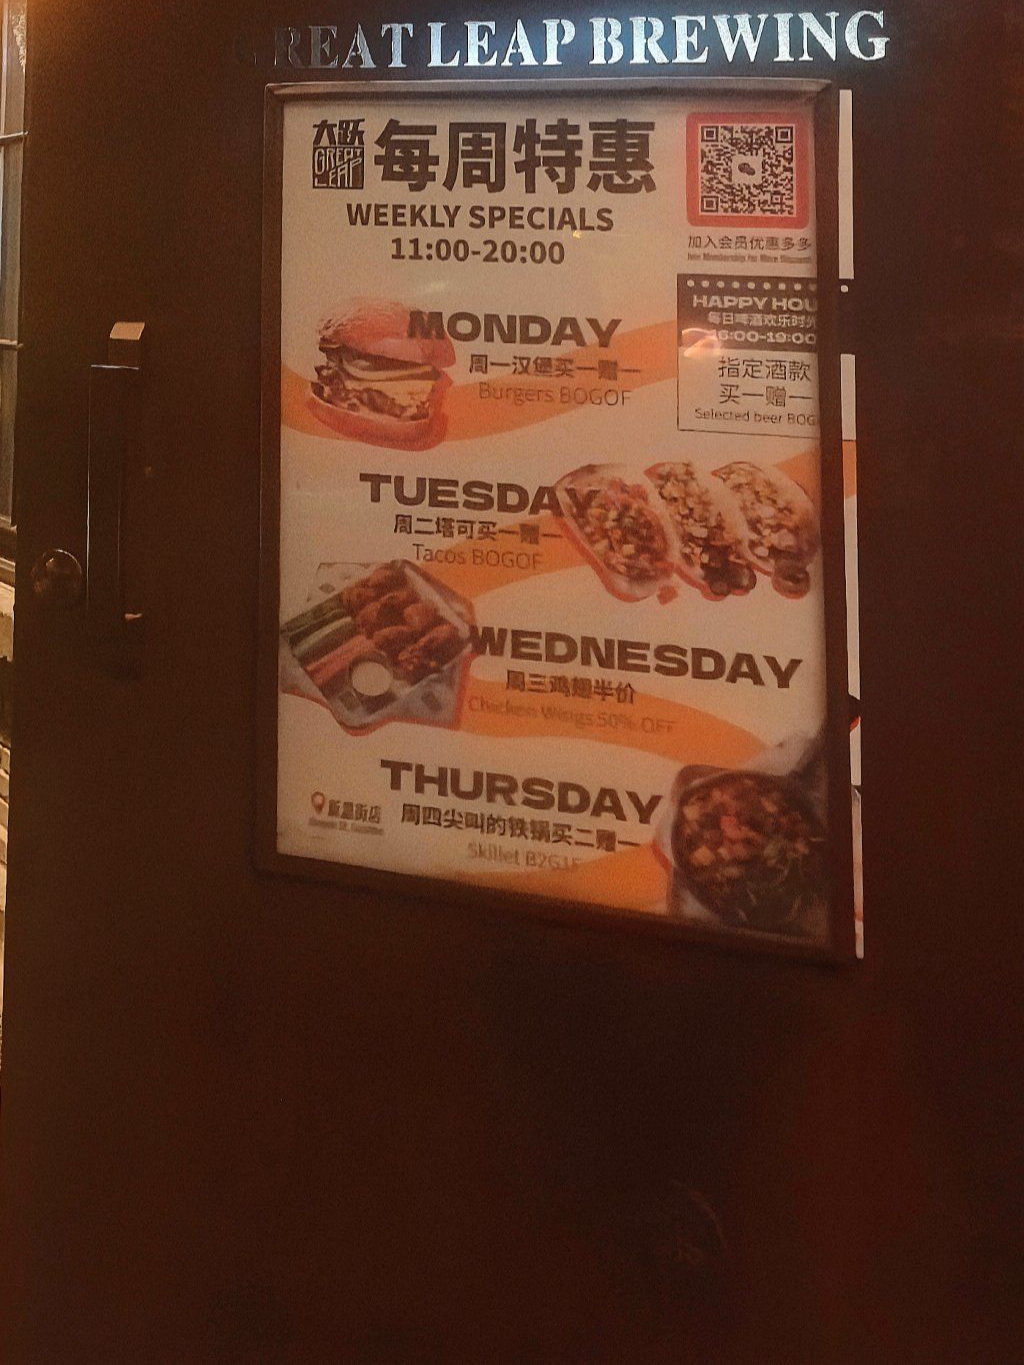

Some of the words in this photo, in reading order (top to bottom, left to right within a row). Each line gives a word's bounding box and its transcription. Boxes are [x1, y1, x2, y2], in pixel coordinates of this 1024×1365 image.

[272, 22, 414, 68] REAT
[427, 18, 576, 67] LEAP
[589, 10, 891, 65] BREWING
[373, 117, 657, 195] 每周特惠
[346, 203, 461, 228] WEEKLY
[469, 205, 614, 232] SPECIALS
[391, 237, 565, 265] 11:00-20:00
[692, 295, 768, 310] HAPPY
[771, 297, 818, 312] HOU
[407, 311, 622, 348] MONDAY
[718, 356, 812, 382] 指定酒款
[478, 382, 554, 406] Burgers
[559, 387, 632, 407] BOGOF
[719, 383, 814, 407] 买一赠一
[694, 408, 750, 422] Selected
[754, 411, 782, 423] beer
[787, 413, 818, 426] BOG
[359, 473, 600, 517] TUESDAY
[412, 543, 466, 564] Tacos
[472, 549, 545, 571] BOGOF
[474, 626, 803, 689] WEDNESDAY
[380, 759, 663, 824] THURSDAY
